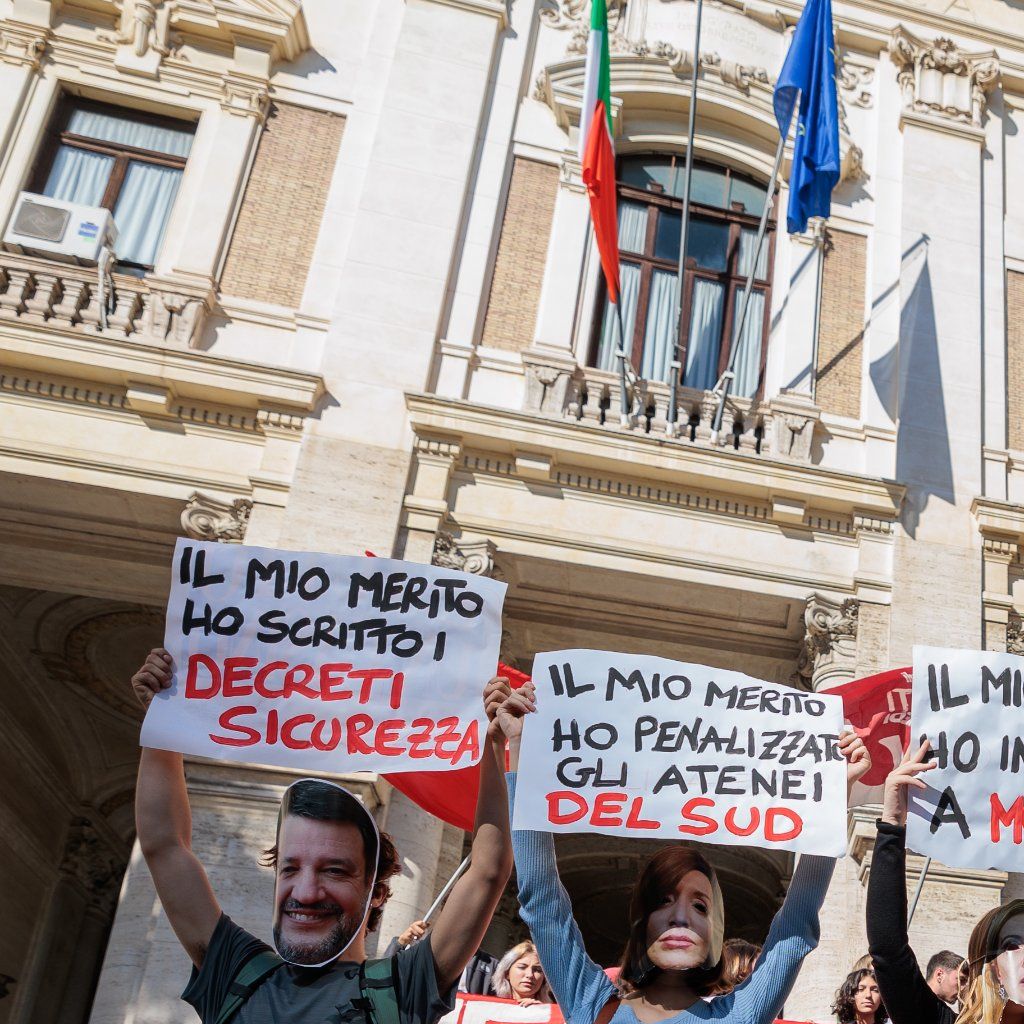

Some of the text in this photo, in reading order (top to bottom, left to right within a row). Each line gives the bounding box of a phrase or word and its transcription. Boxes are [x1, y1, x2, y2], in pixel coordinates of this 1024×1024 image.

[180, 547, 484, 618] IL MIO MERITO
[182, 599, 446, 660] HO SCRITTO I
[185, 653, 404, 709] DECRETI
[548, 663, 825, 717] IL MIO MERITO
[928, 663, 969, 712] IL
[209, 706, 480, 765] SICUREZZA
[552, 718, 618, 752] HO
[920, 731, 981, 773] HO
[557, 757, 822, 802] GLI ATENEI
[546, 791, 803, 841] DEL SUD
[929, 785, 971, 839] A
